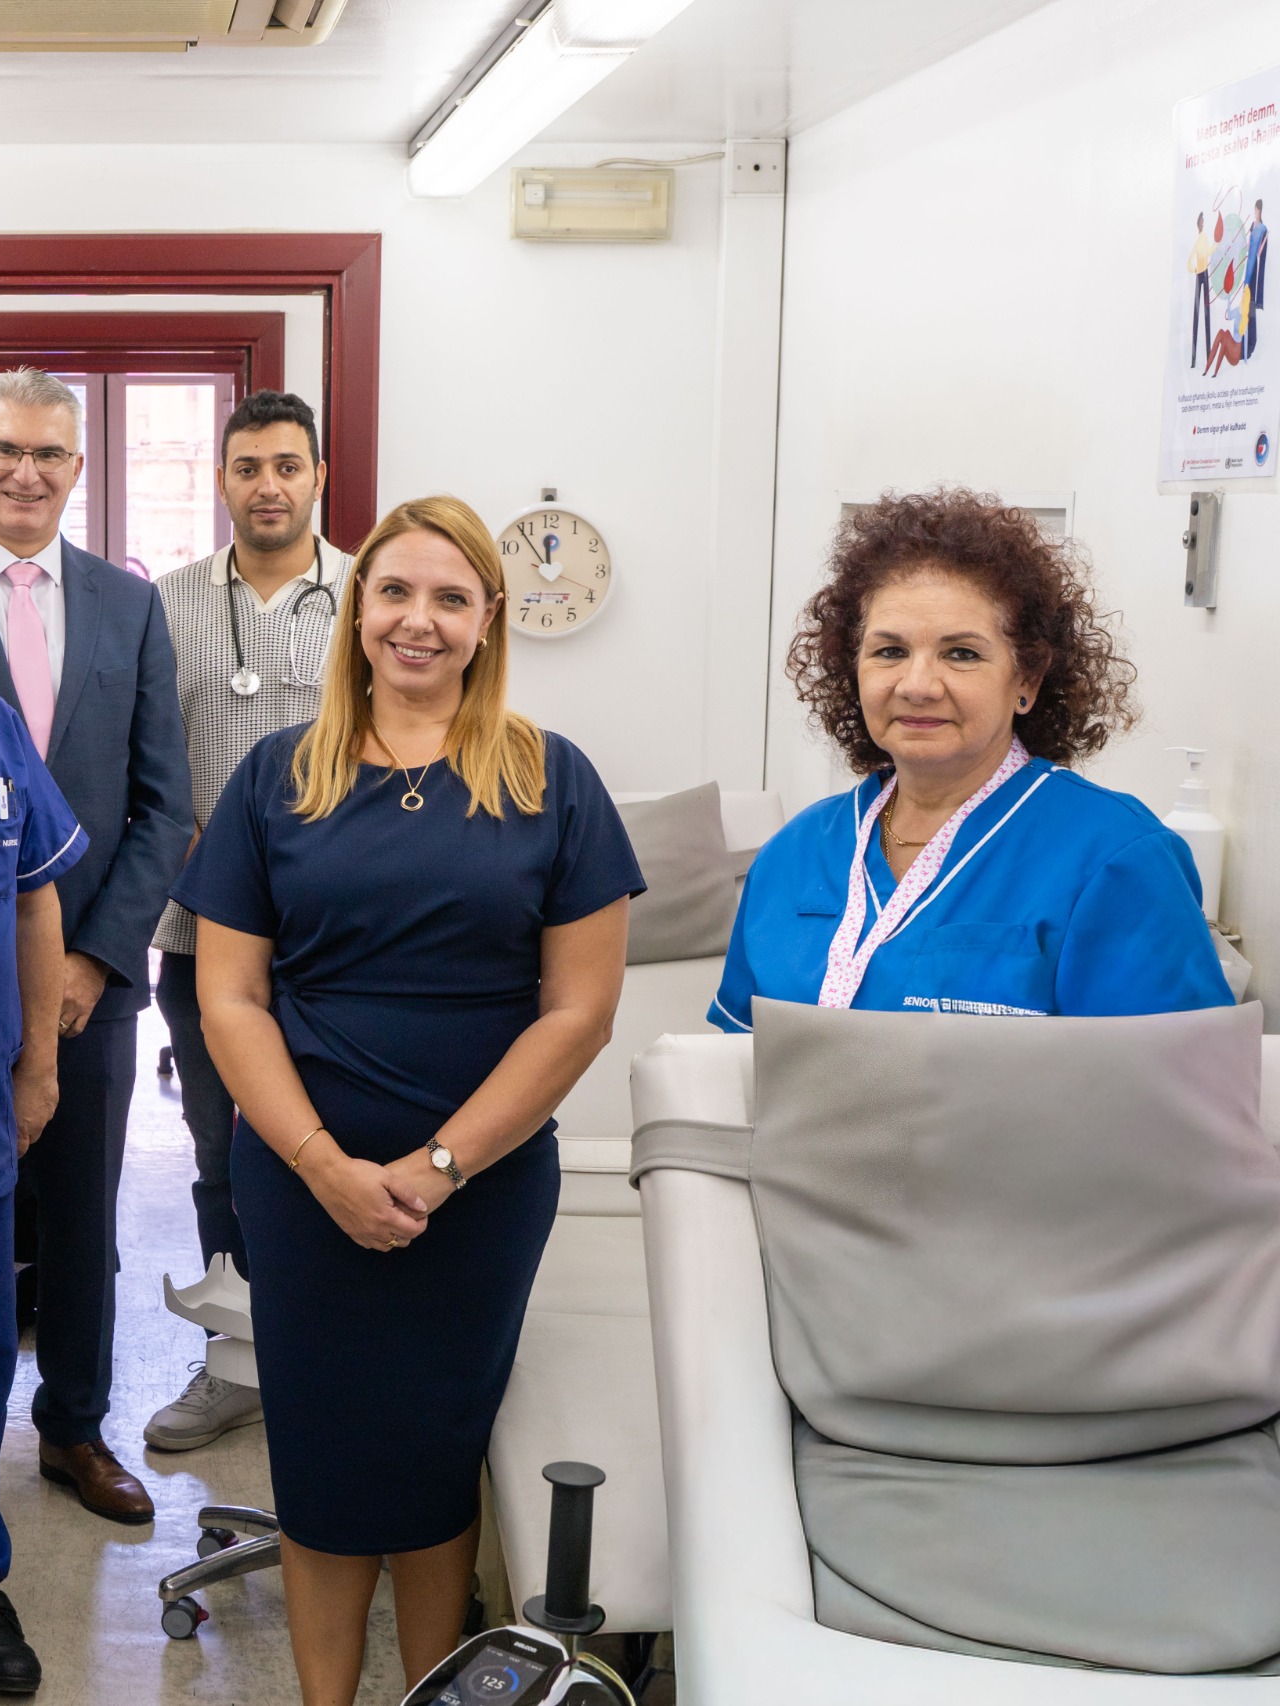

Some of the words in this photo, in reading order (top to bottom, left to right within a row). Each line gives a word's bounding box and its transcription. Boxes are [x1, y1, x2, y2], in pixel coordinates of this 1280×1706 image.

[1196, 124, 1217, 143] Meta
[1247, 103, 1278, 124] demm,
[519, 521, 534, 536] 11
[543, 514, 559, 529] 12
[571, 521, 578, 535] 1
[501, 540, 519, 555] 10
[589, 538, 599, 553] 2
[595, 564, 606, 578] 3
[584, 589, 596, 603] 4
[519, 607, 530, 622] 7
[541, 613, 553, 627] 6
[566, 607, 577, 622] 5
[903, 996, 938, 1009] SENIOR
[481, 1675, 506, 1690] 125
